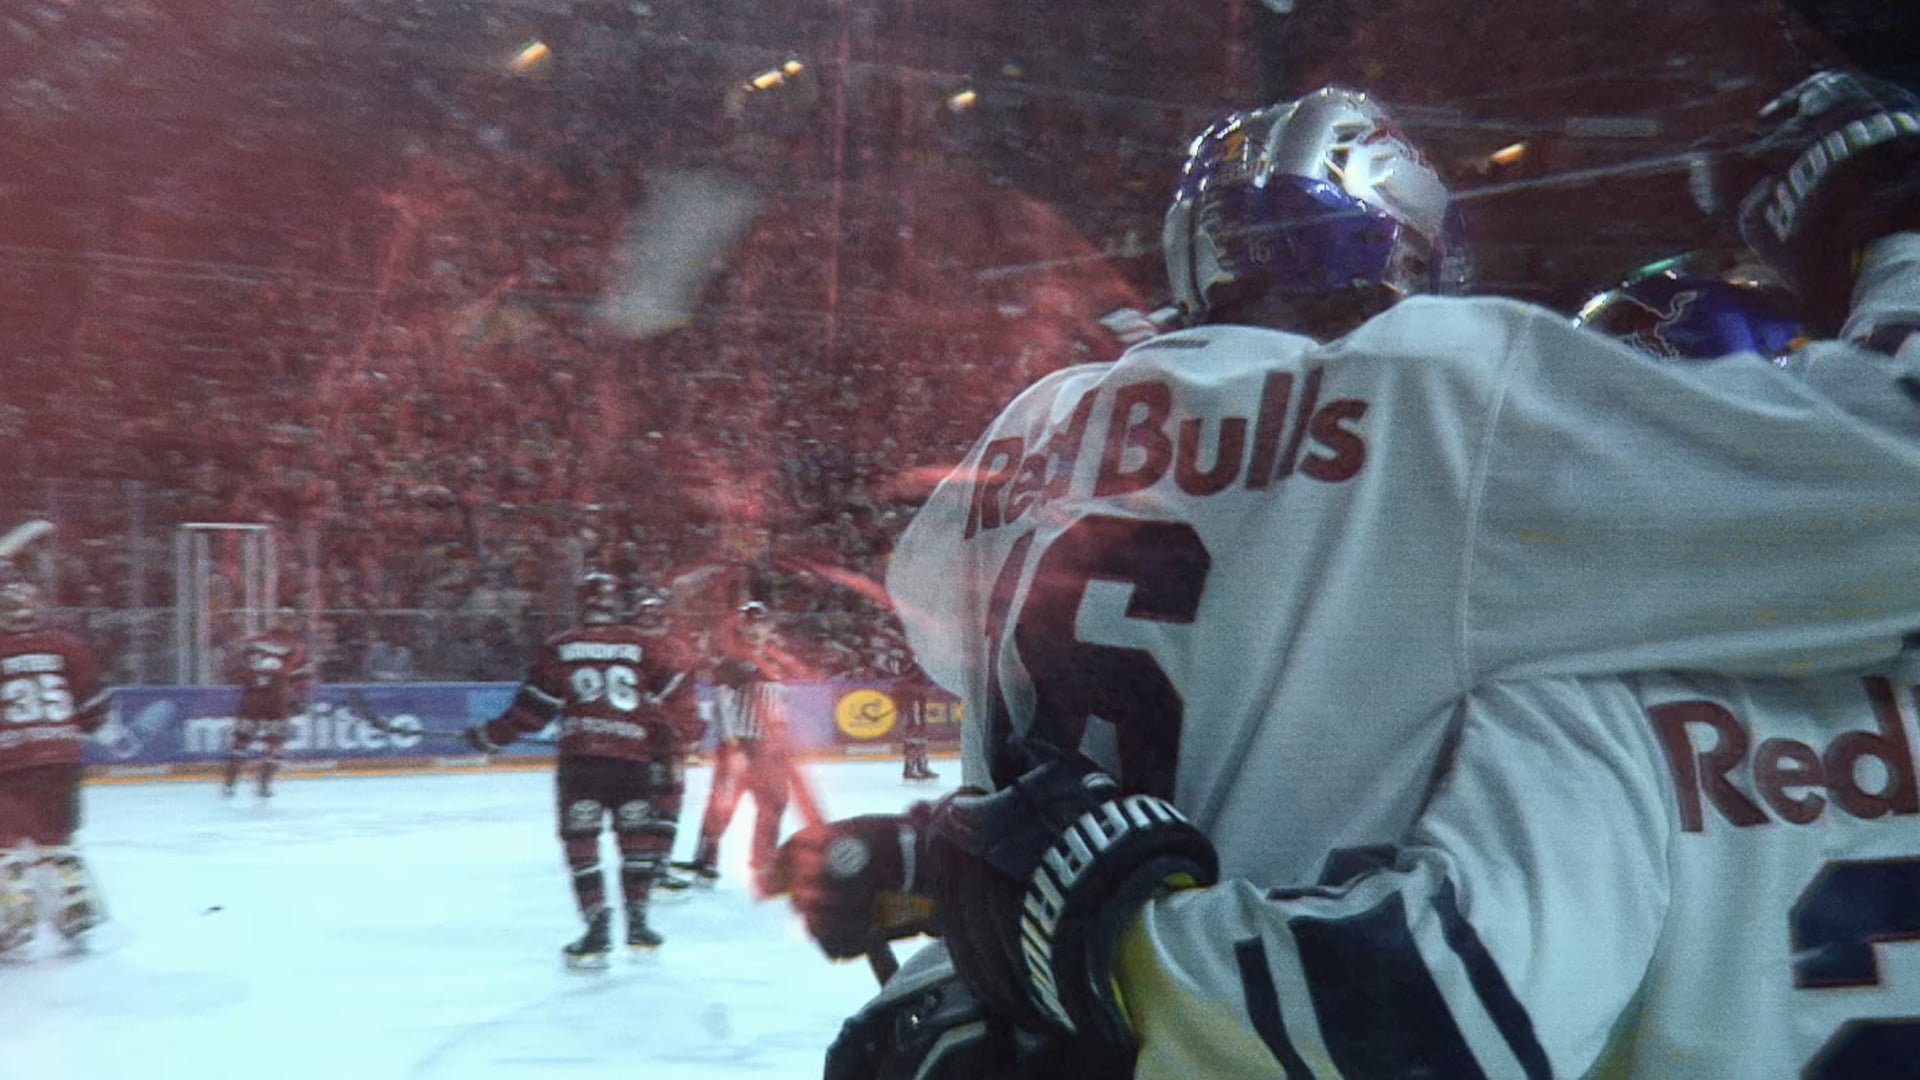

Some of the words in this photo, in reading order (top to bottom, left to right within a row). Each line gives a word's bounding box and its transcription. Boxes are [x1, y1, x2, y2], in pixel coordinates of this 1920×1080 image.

[963, 388, 1099, 541] Red
[1093, 365, 1368, 498] Bulls
[1, 673, 75, 723] 35
[1648, 675, 1920, 834] Red
